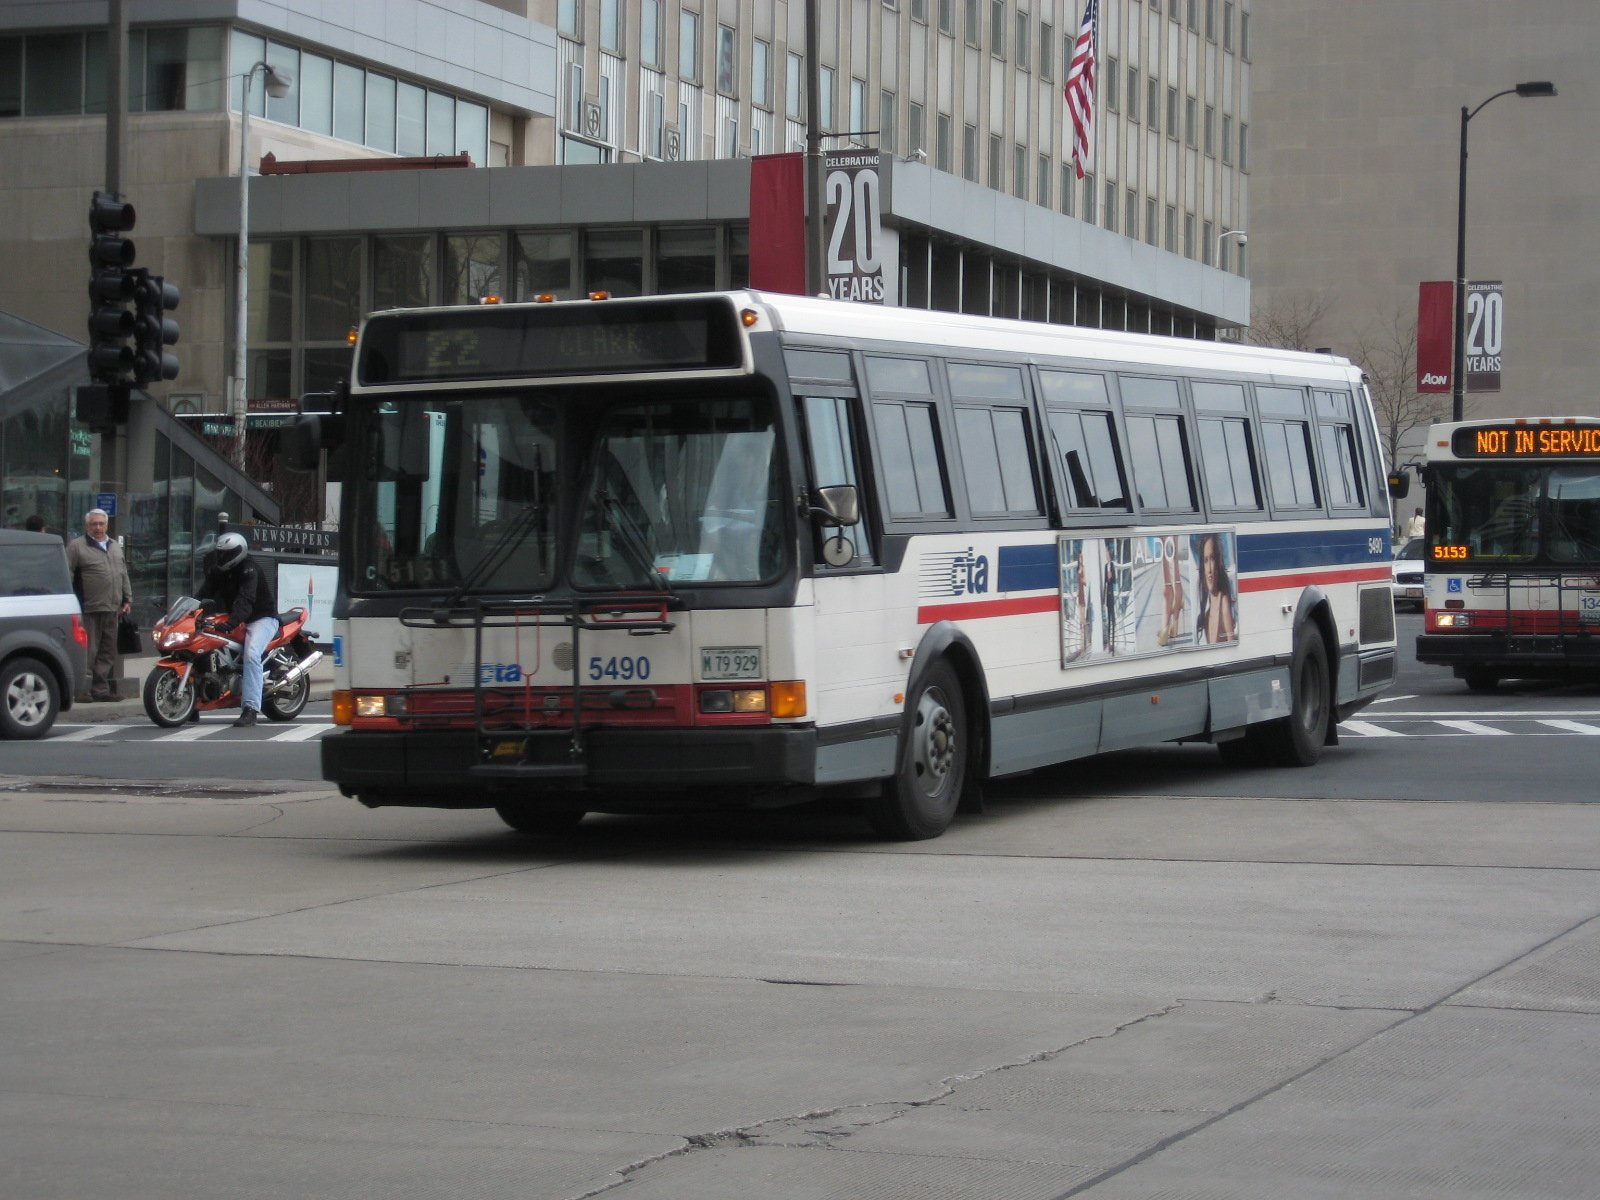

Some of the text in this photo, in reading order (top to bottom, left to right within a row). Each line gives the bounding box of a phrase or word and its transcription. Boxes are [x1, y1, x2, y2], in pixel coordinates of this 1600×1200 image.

[825, 155, 880, 167] CELEBRATING
[826, 169, 882, 274] 20
[828, 276, 885, 301] YEARS
[1467, 292, 1503, 356] 20
[426, 329, 480, 367] 22
[1466, 356, 1501, 372] YEARS
[1477, 429, 1600, 453] NOT IN SERVIC
[253, 528, 331, 547] NEWSPAPERS
[1134, 536, 1175, 564] ALDO
[1434, 546, 1467, 559] 5153
[588, 655, 651, 681] 5490
[715, 655, 730, 672] 79
[733, 654, 758, 672] 929
